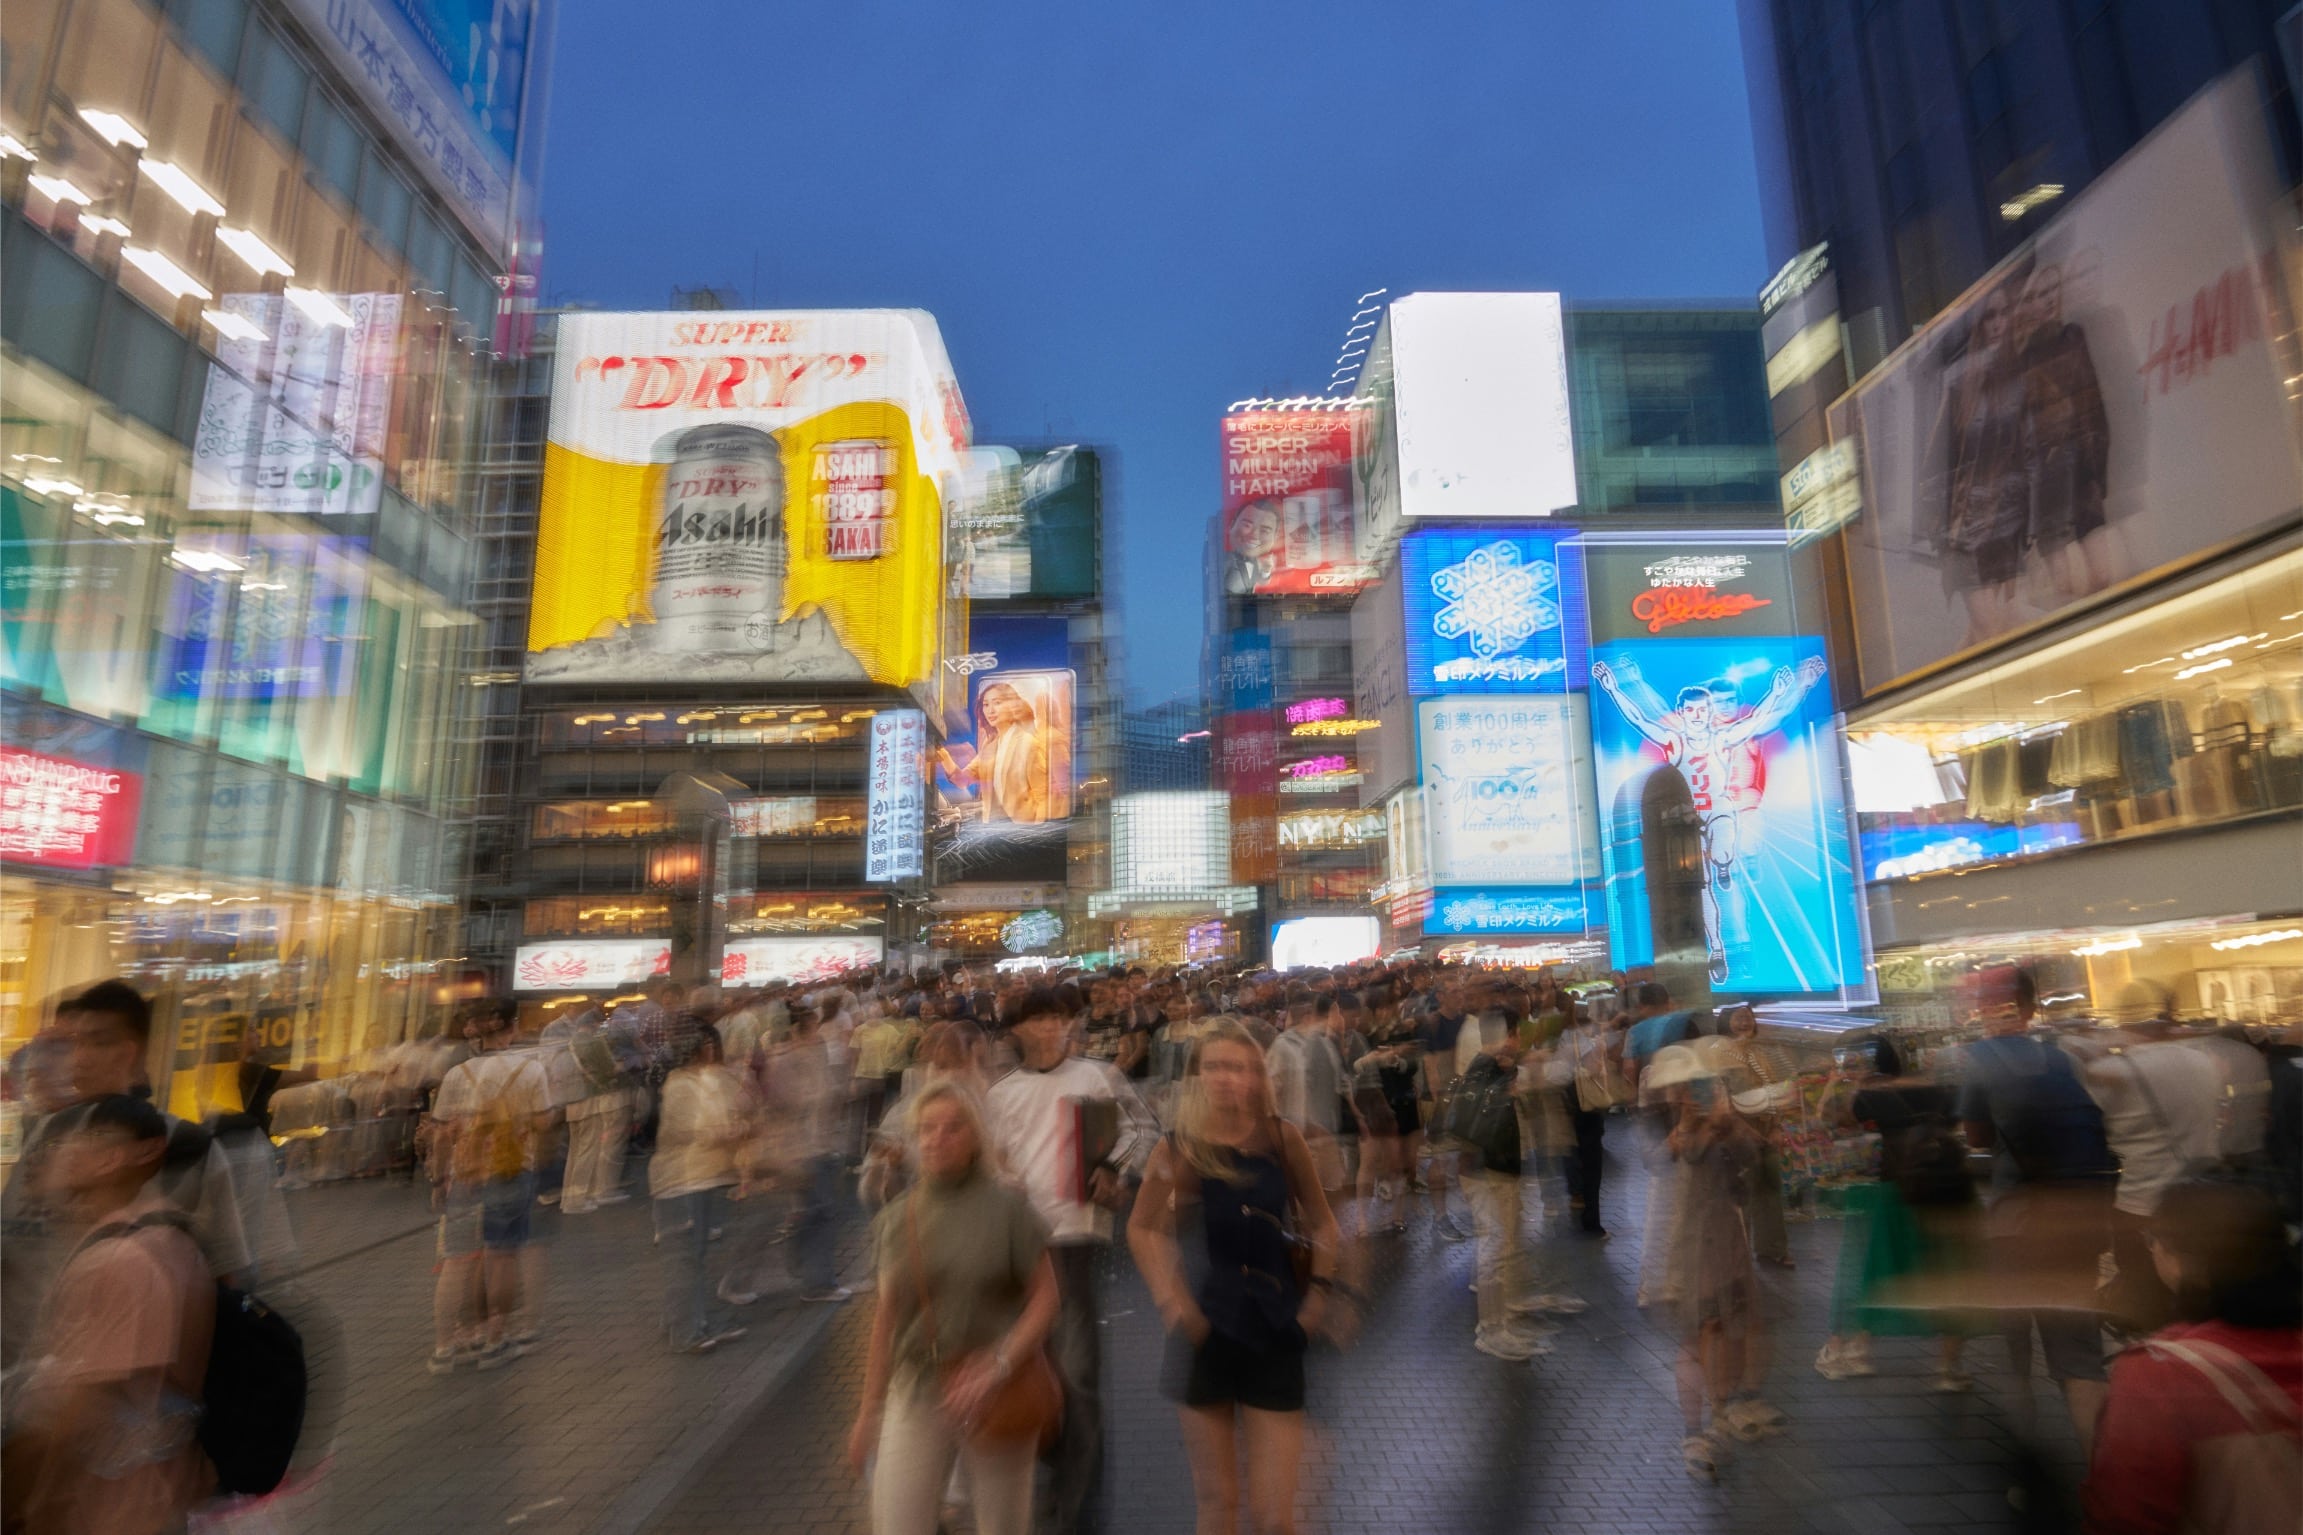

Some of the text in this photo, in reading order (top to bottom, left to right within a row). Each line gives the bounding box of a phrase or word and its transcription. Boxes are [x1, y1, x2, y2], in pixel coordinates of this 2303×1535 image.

[671, 320, 797, 346] SUPER
[1229, 437, 1309, 454] SUPER
[812, 453, 876, 481] ASAHI
[1229, 458, 1318, 475] MILLION
[828, 482, 859, 493] since
[1230, 479, 1289, 496] HAIR
[810, 493, 874, 521] 1889
[651, 502, 768, 549] Asahi
[950, 519, 1003, 529] 思いのままに
[815, 527, 872, 555] SAKA
[1651, 578, 1716, 588] ゆたかな人生
[1434, 664, 1541, 682] 雪印メグミルク
[1433, 711, 1548, 730] 創業100周年
[1450, 738, 1536, 754] ありがとう
[1688, 753, 1713, 811] グリコ
[1476, 914, 1562, 928] 雪印メグミルク
